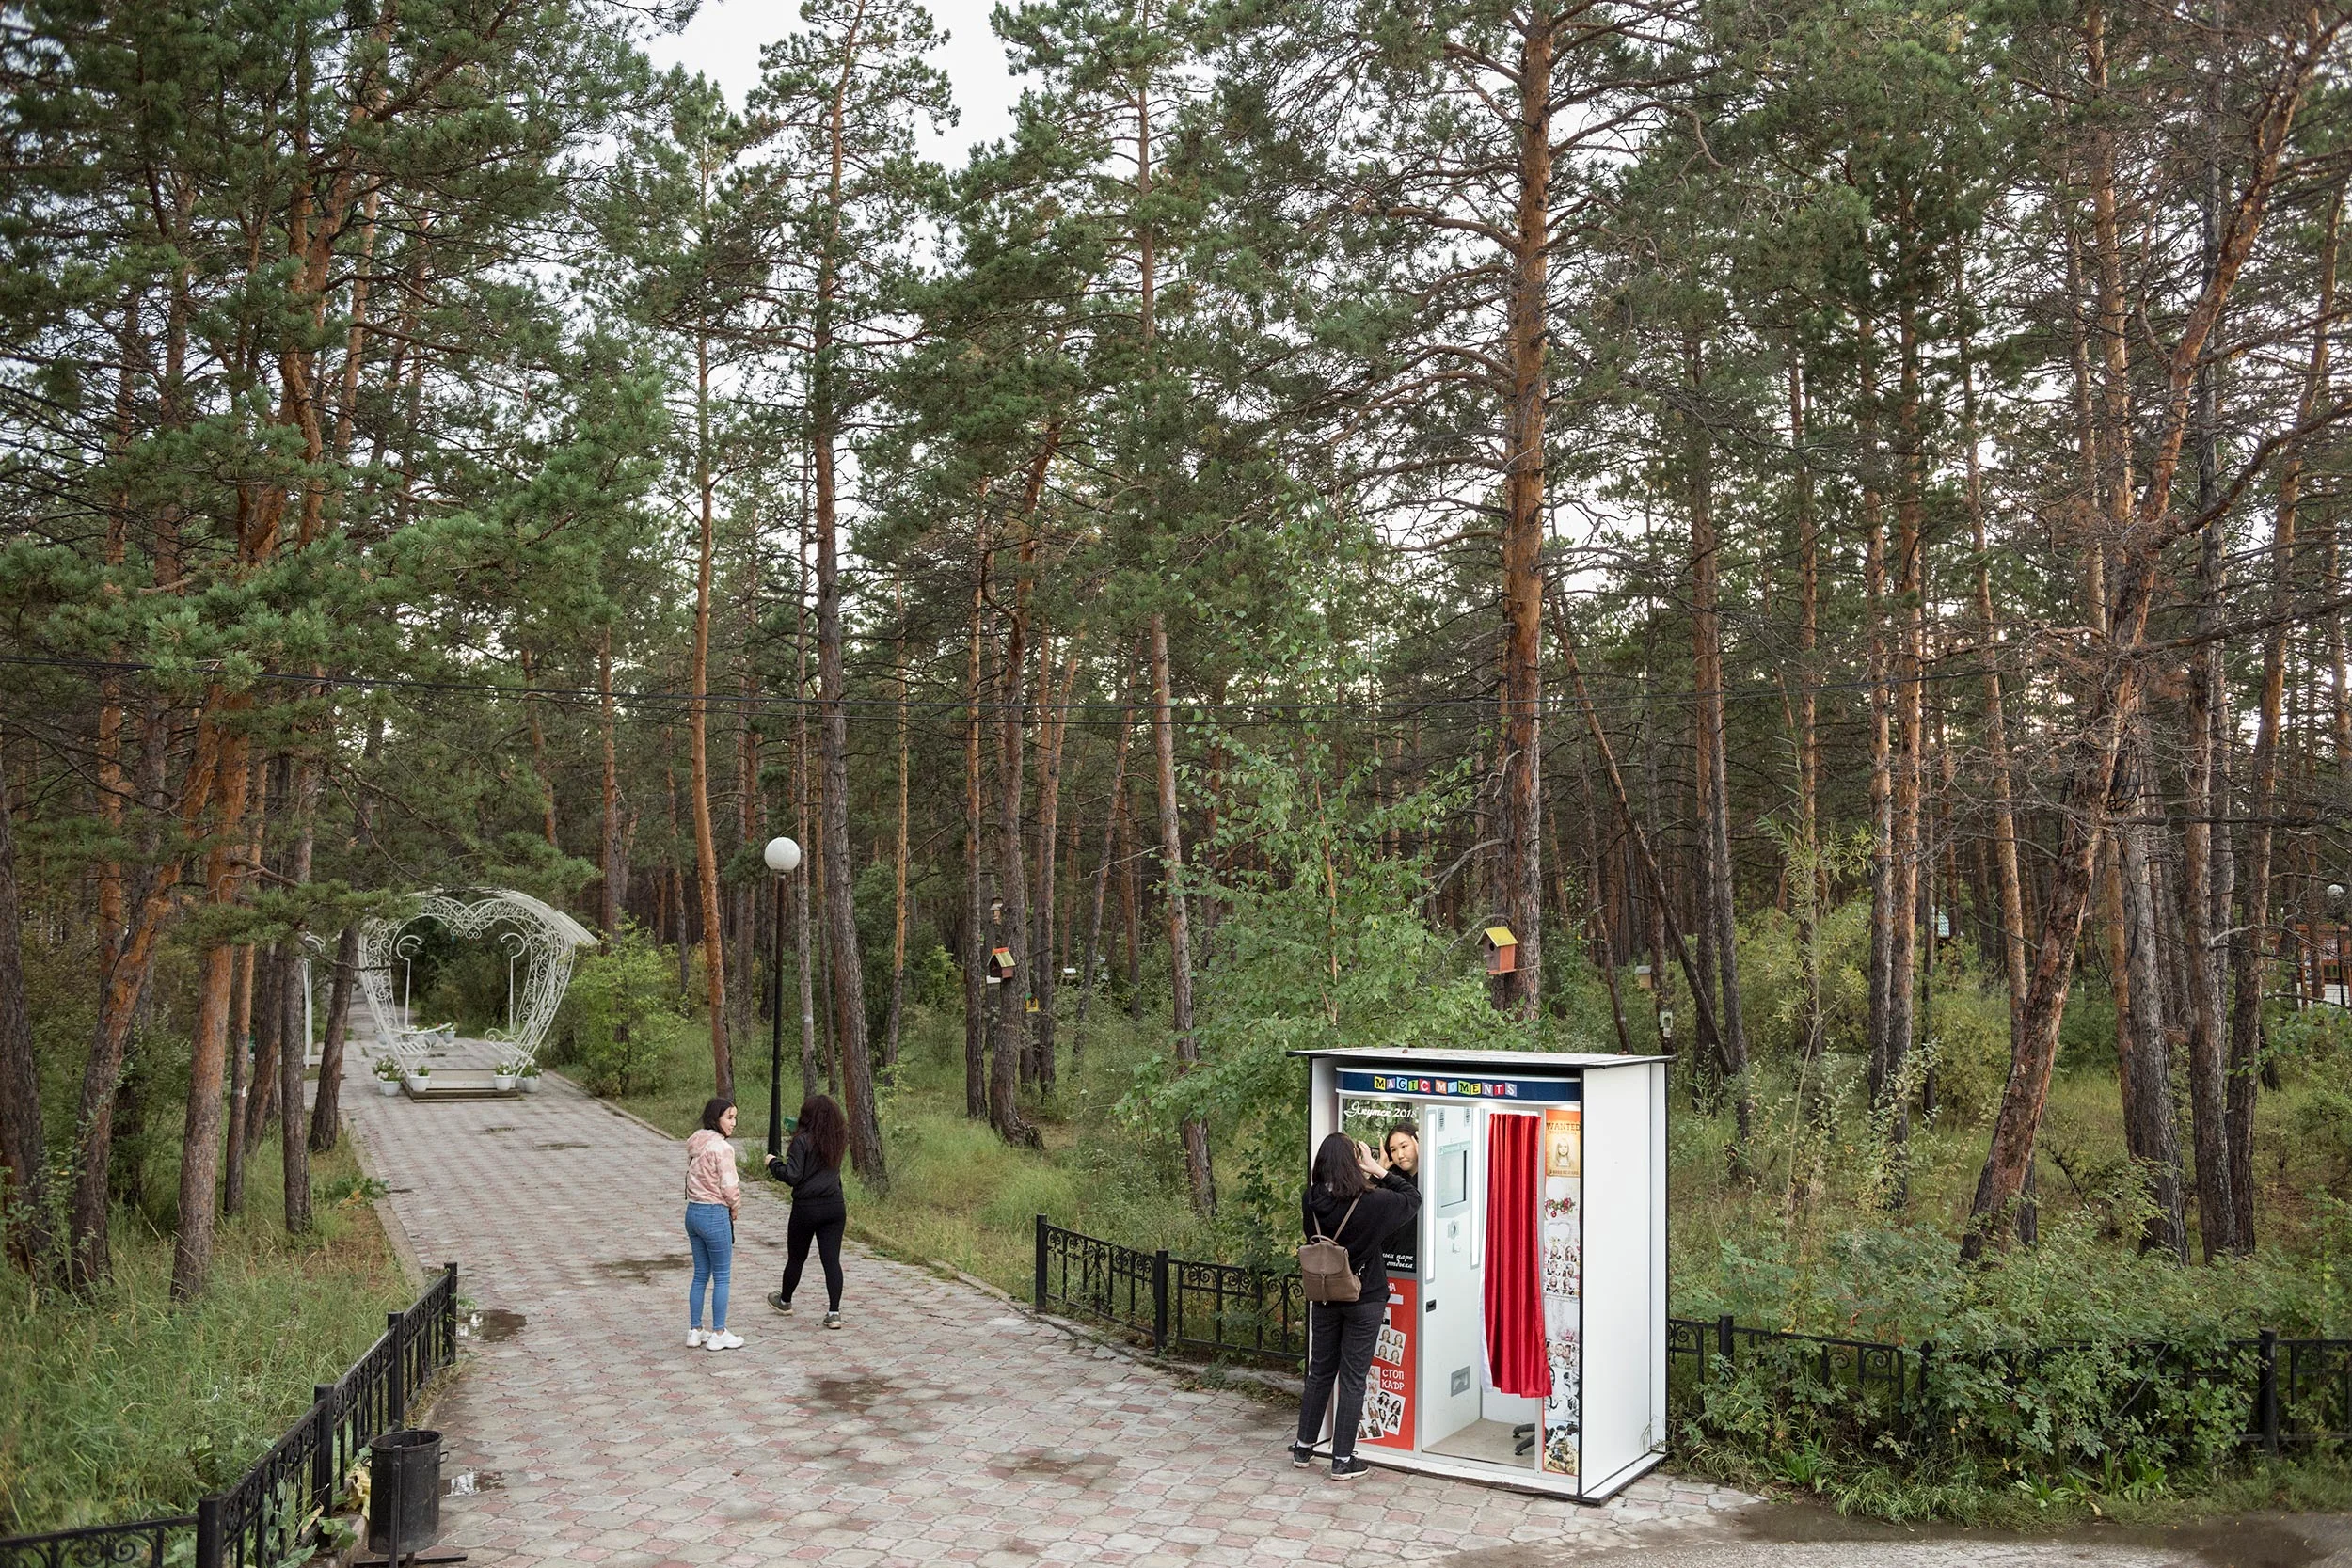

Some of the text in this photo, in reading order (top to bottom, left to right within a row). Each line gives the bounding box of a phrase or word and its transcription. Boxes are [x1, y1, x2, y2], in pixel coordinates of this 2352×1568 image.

[1375, 1077, 1517, 1097] MAGIC MOMENTS
[1392, 1108, 1417, 1118] 2018
[1546, 1122, 1581, 1132] WANTED
[1382, 1369, 1405, 1380] СТОП
[1381, 1378, 1405, 1390] КАДР
